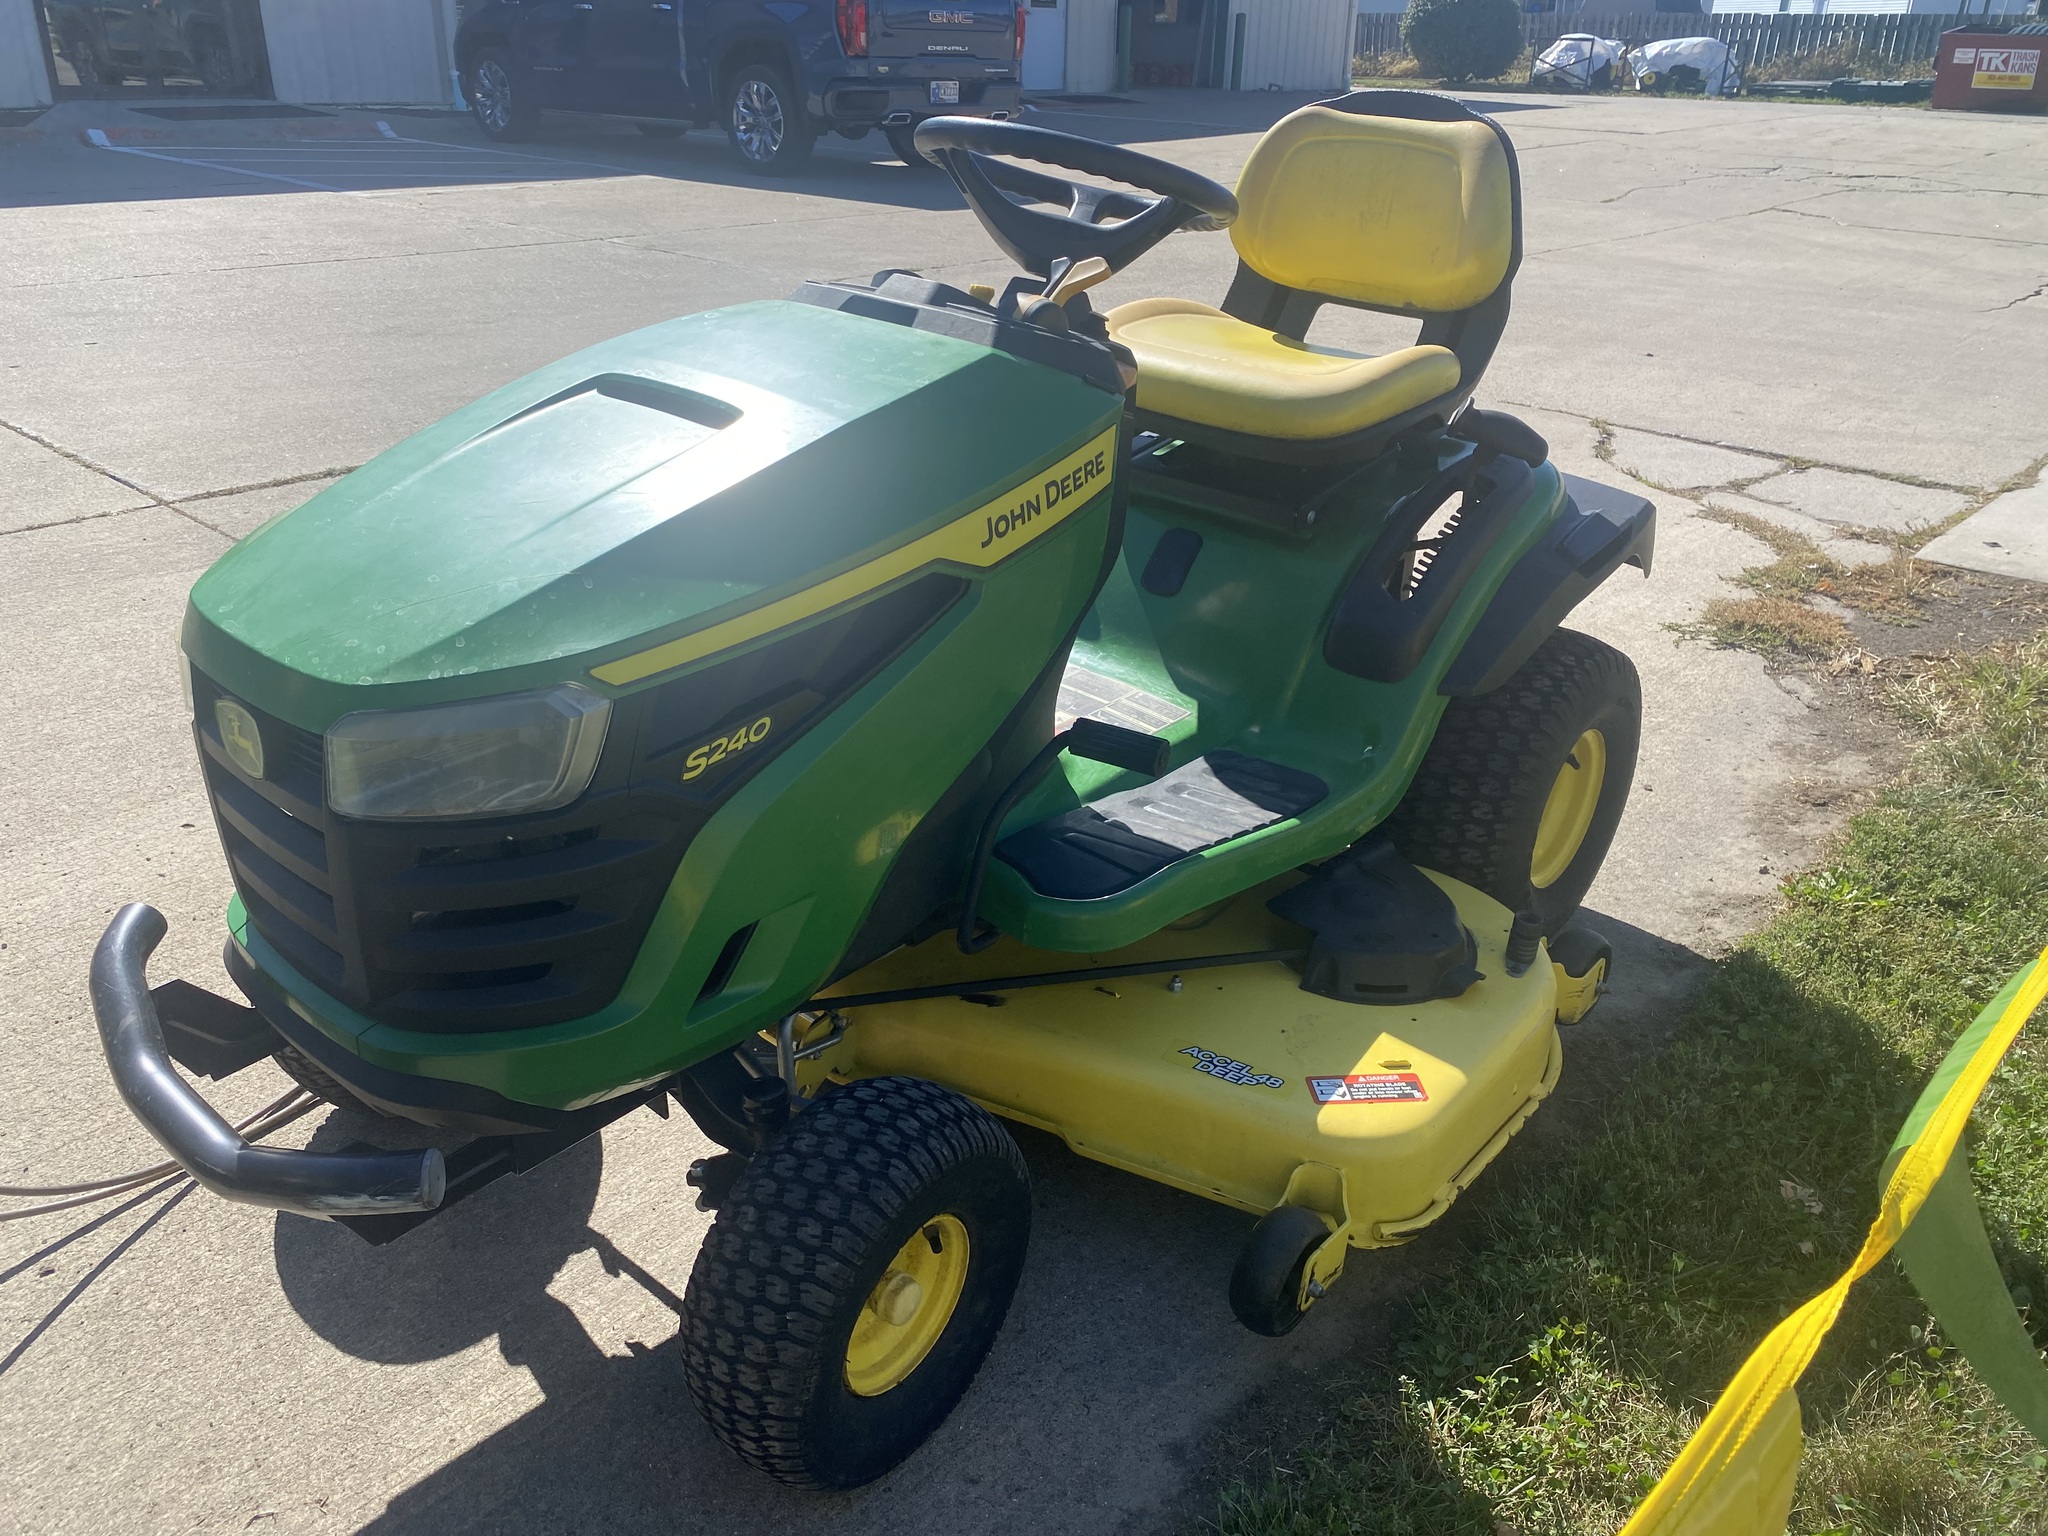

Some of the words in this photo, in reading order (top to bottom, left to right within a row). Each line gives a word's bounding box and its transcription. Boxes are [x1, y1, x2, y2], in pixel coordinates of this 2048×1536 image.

[929, 10, 973, 24] GMC
[1981, 52, 2010, 71] TK
[2011, 62, 2036, 73] KANS
[2013, 52, 2038, 61] TRASH
[981, 493, 1041, 549] JOHN
[1044, 450, 1105, 510] DEERE
[682, 716, 772, 781] S240
[1178, 1046, 1254, 1077] ACCEL
[1252, 1074, 1284, 1088] 48
[1193, 1060, 1259, 1085] DEEP
